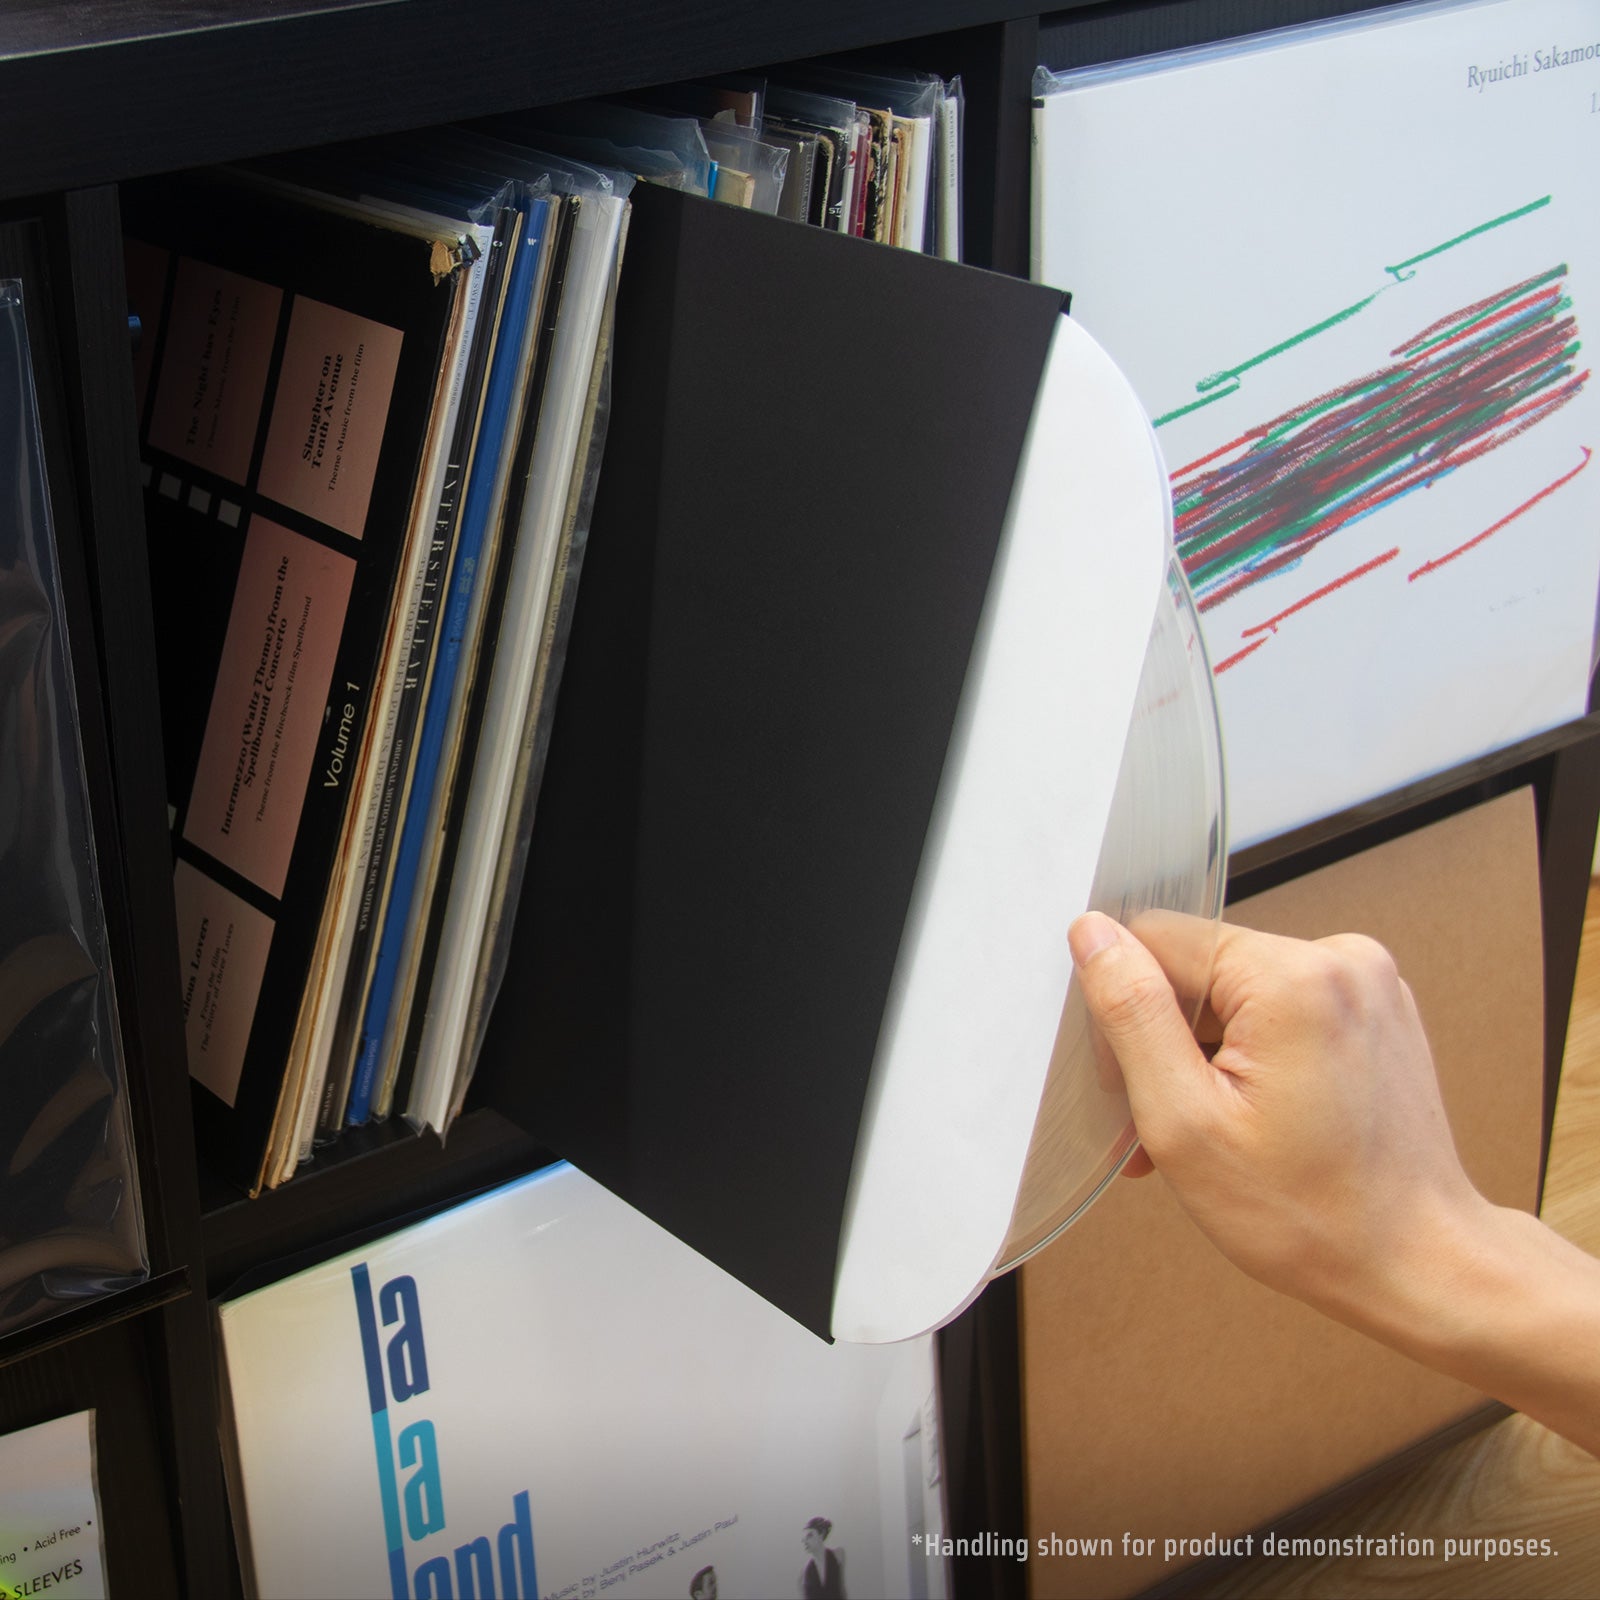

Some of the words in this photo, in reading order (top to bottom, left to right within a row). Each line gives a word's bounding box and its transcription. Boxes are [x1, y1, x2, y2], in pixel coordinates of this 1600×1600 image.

[1467, 54, 1528, 93] Ryuichi
[186, 415, 200, 447] The
[193, 365, 209, 409] Night
[208, 288, 222, 327] Eyes
[353, 343, 365, 367] film
[351, 368, 360, 387] the
[302, 379, 327, 462] Slaughter
[321, 354, 332, 378] on
[311, 421, 330, 469] Tenth
[323, 353, 344, 418] Avenue
[344, 387, 356, 416] from
[336, 417, 350, 452] Music
[327, 454, 342, 492] Theme
[404, 464, 460, 689] INTERSTELLAR
[414, 556, 427, 592] THE
[293, 596, 313, 660] Spellbound
[393, 601, 419, 695] TORTURED
[288, 662, 299, 684] film
[221, 747, 249, 836] Intermezzo
[242, 692, 262, 746] (Waltz
[253, 627, 276, 688] Theme)
[267, 590, 285, 627] from
[277, 555, 290, 588] the
[243, 696, 271, 788] Spellbound
[263, 617, 288, 692] Concerto
[275, 685, 294, 741] Hitchcock
[324, 704, 356, 789] Volume
[345, 681, 361, 693] 1
[381, 700, 399, 754] POETS
[271, 741, 281, 760] the
[388, 739, 404, 787] ORIGINAL
[264, 761, 278, 787] from
[255, 787, 269, 824] Theme
[357, 759, 387, 871] DEPARTMENT
[381, 787, 394, 825] MOTION
[373, 826, 387, 867] PICTURE
[359, 867, 379, 932] SOUNDTRACK
[211, 947, 221, 969] film
[221, 923, 234, 954] Loves
[183, 975, 197, 1018] alous
[190, 917, 209, 970] Lovers
[207, 970, 216, 989] the
[216, 957, 226, 984] three
[200, 990, 211, 1021] From
[213, 986, 221, 1001] of
[206, 1002, 217, 1031] Story
[201, 1031, 210, 1053] The
[350, 1262, 430, 1415] la
[372, 1407, 446, 1554] la
[34, 1532, 58, 1551] Acid
[59, 1526, 82, 1541] Free
[582, 1587, 596, 1600] by
[629, 1553, 664, 1576] Pasek
[680, 1529, 713, 1551] Justin
[714, 1512, 739, 1532] Paul
[13, 1558, 84, 1600] SLEEVES
[582, 1574, 596, 1588] by
[600, 1555, 635, 1578] Justin
[637, 1532, 681, 1559] Hurwitz
